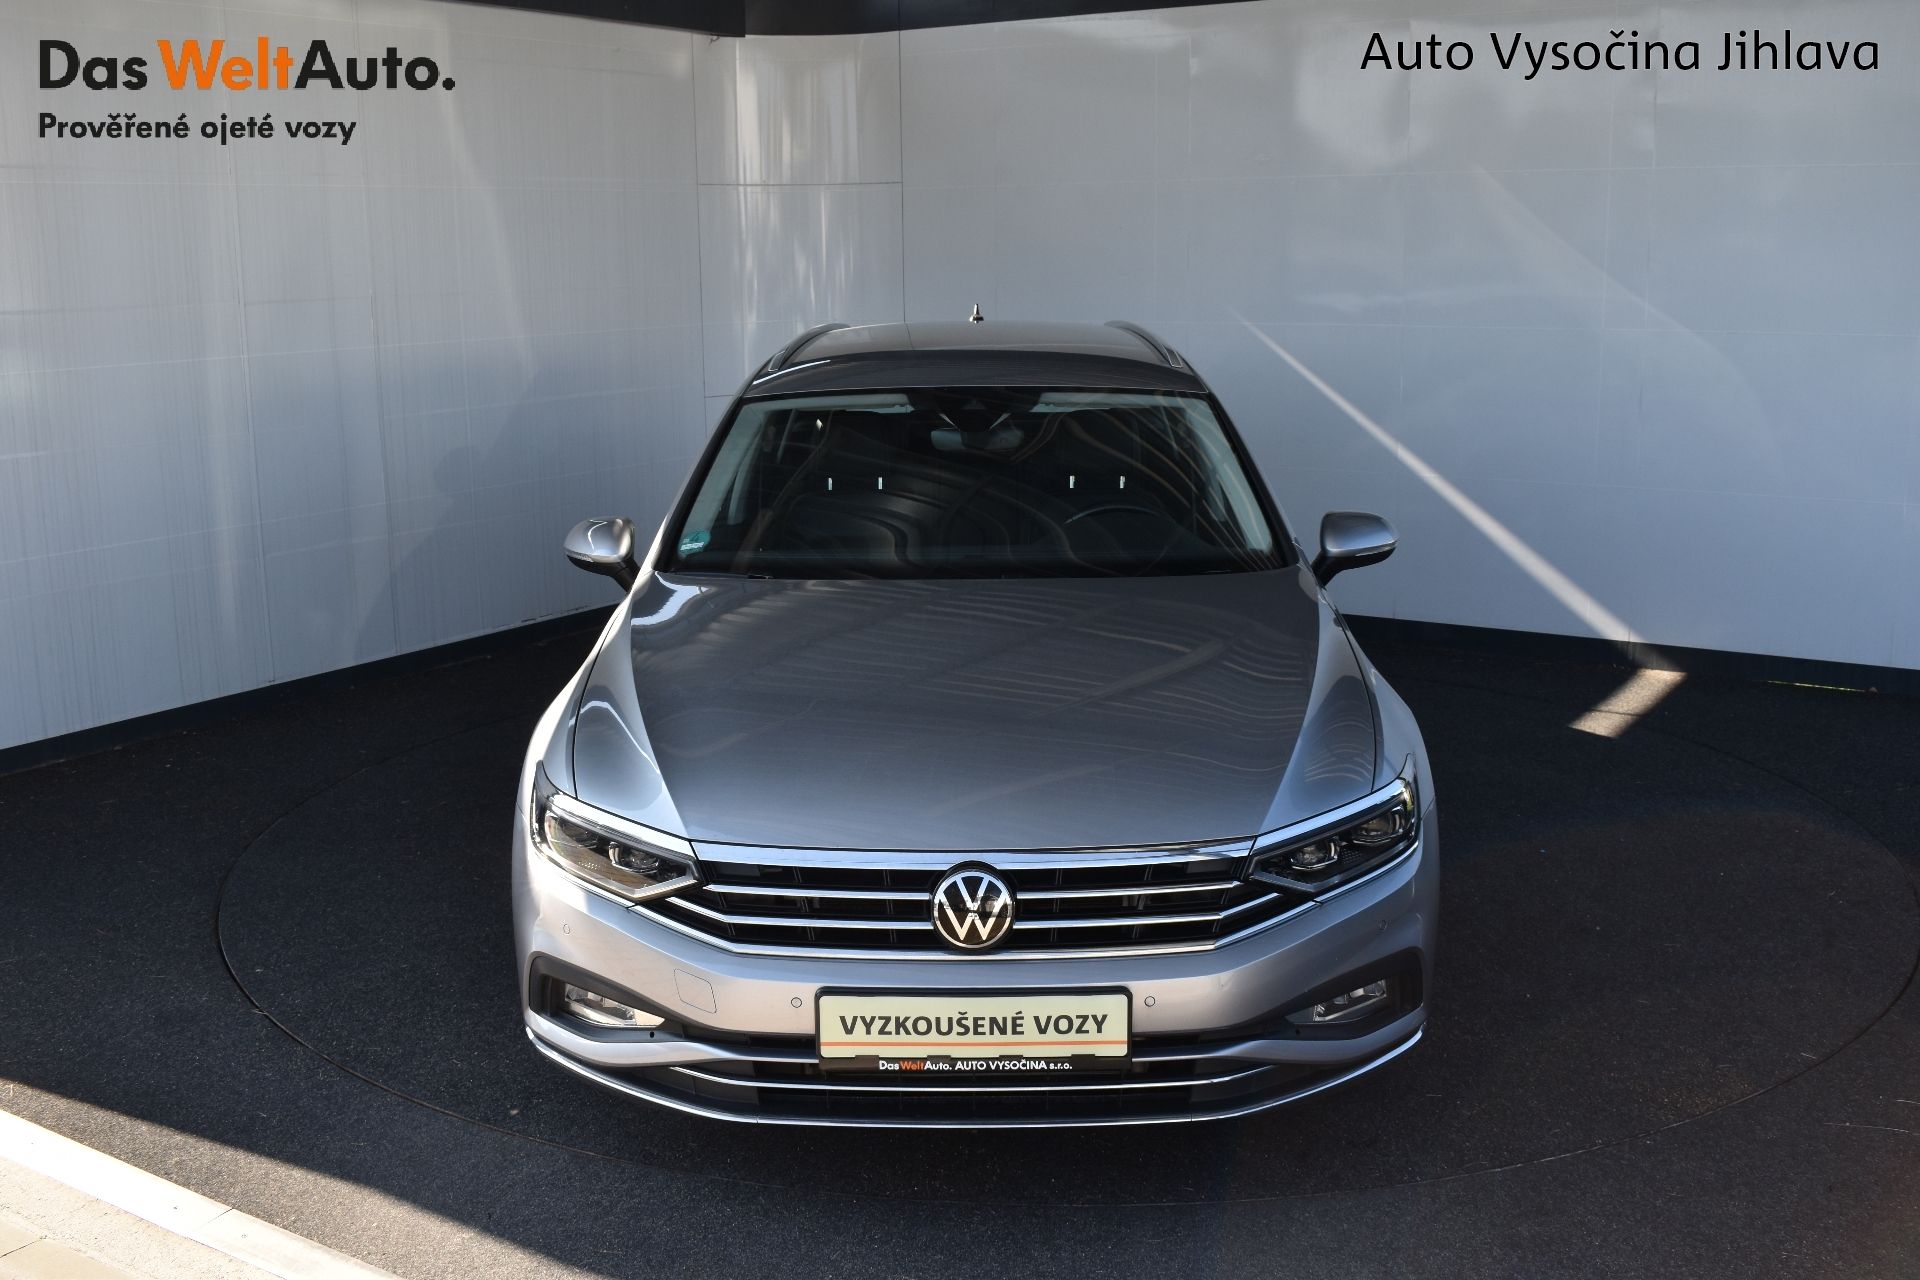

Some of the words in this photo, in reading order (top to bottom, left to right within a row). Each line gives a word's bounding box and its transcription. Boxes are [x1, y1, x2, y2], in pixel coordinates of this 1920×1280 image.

[839, 1010, 1025, 1036] VYZKOUŠENÉ
[1033, 1014, 1108, 1035] VOZY
[878, 1060, 900, 1070] Das
[955, 1060, 987, 1071] AUTO
[988, 1058, 1048, 1070] VYSOČINA
[1049, 1062, 1073, 1070] s.r.o.
